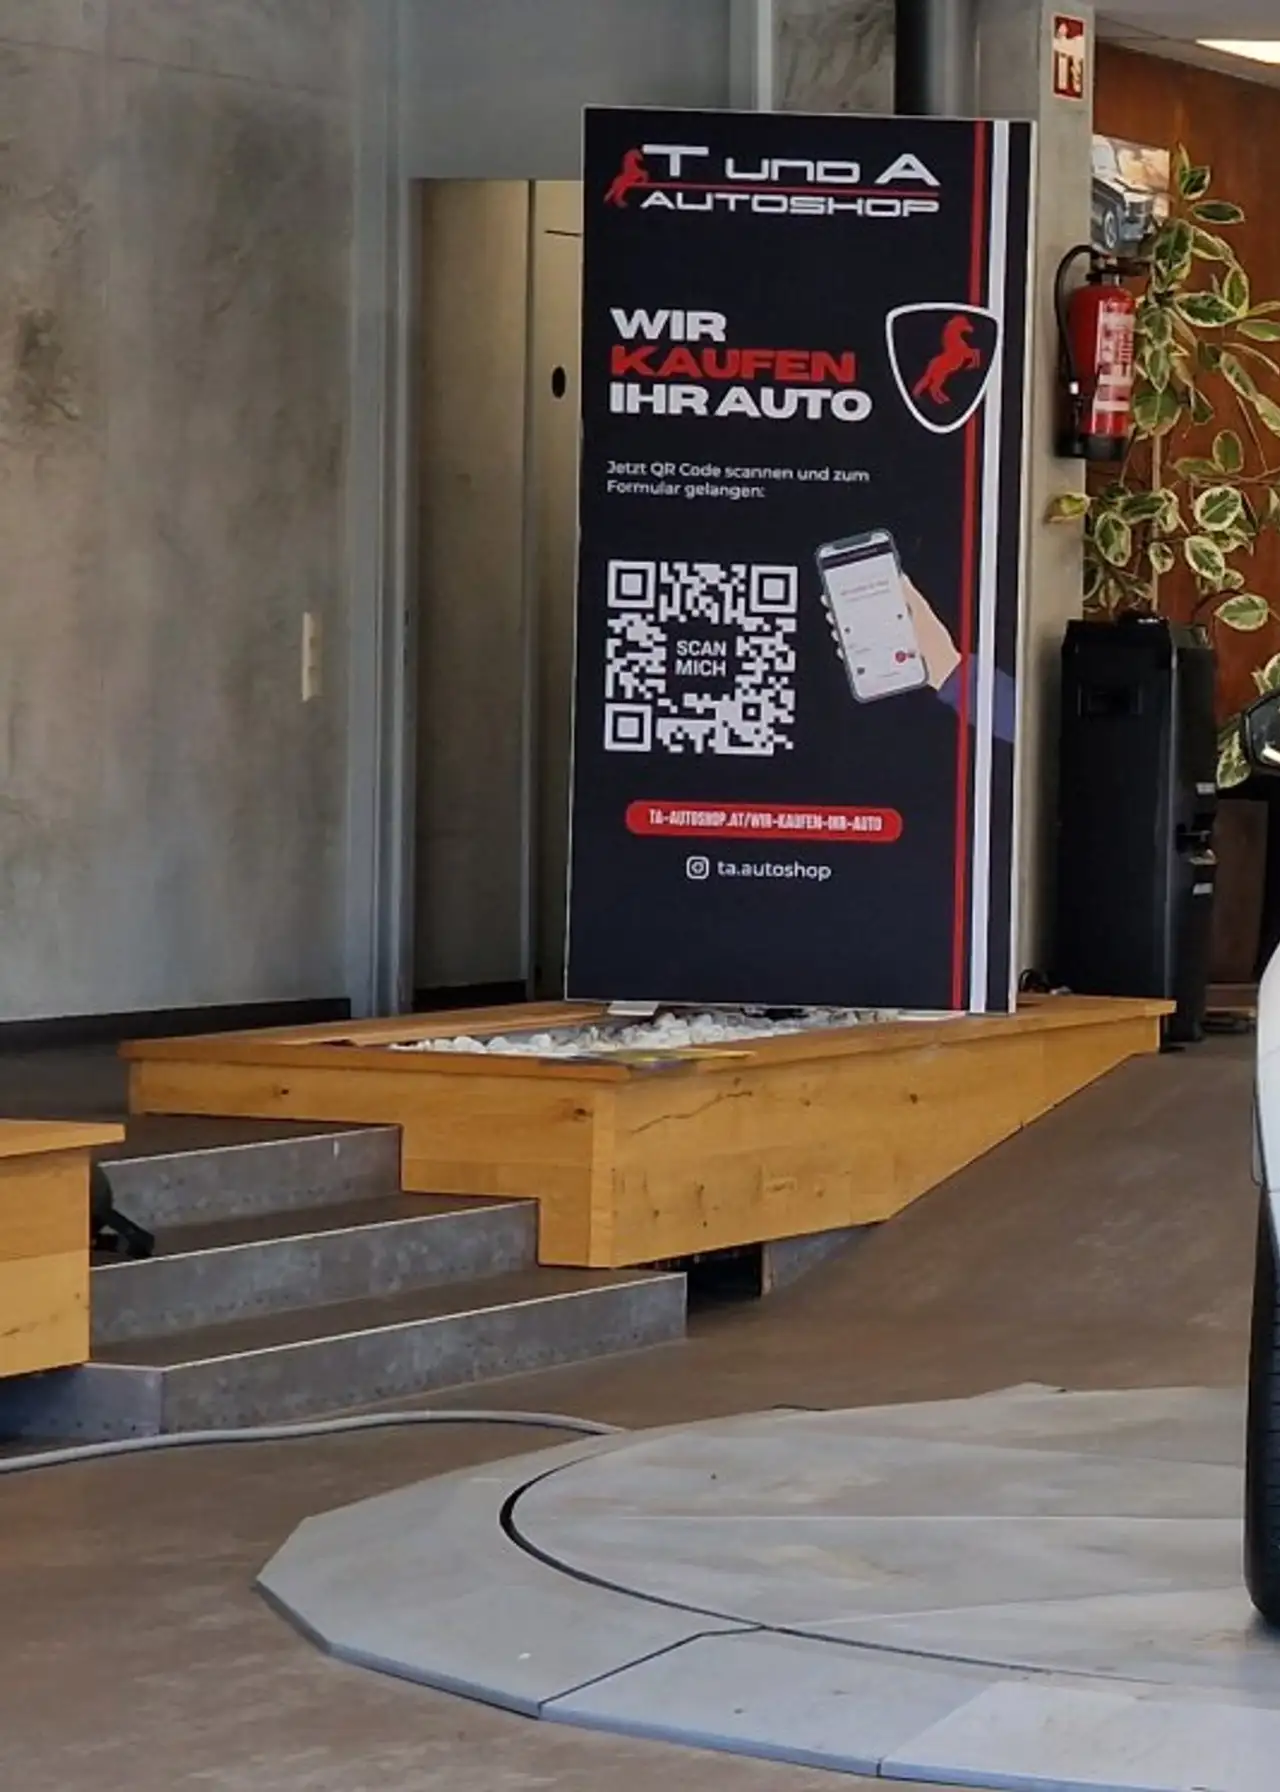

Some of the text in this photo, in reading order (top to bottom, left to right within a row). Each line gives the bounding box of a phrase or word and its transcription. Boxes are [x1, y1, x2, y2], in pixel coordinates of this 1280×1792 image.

[642, 144, 709, 177] T
[874, 153, 941, 187] A
[640, 191, 940, 217] AUTOSHOP
[610, 307, 727, 342] WIR
[610, 344, 856, 383] KAUFEN
[609, 381, 872, 421] IHR AUTO
[606, 460, 870, 482] Jetzt QR Code scannen und zum
[606, 479, 682, 496] Formular
[676, 639, 727, 657] SCAN
[675, 658, 727, 678] MICH
[717, 860, 832, 882] ta.autoshop
